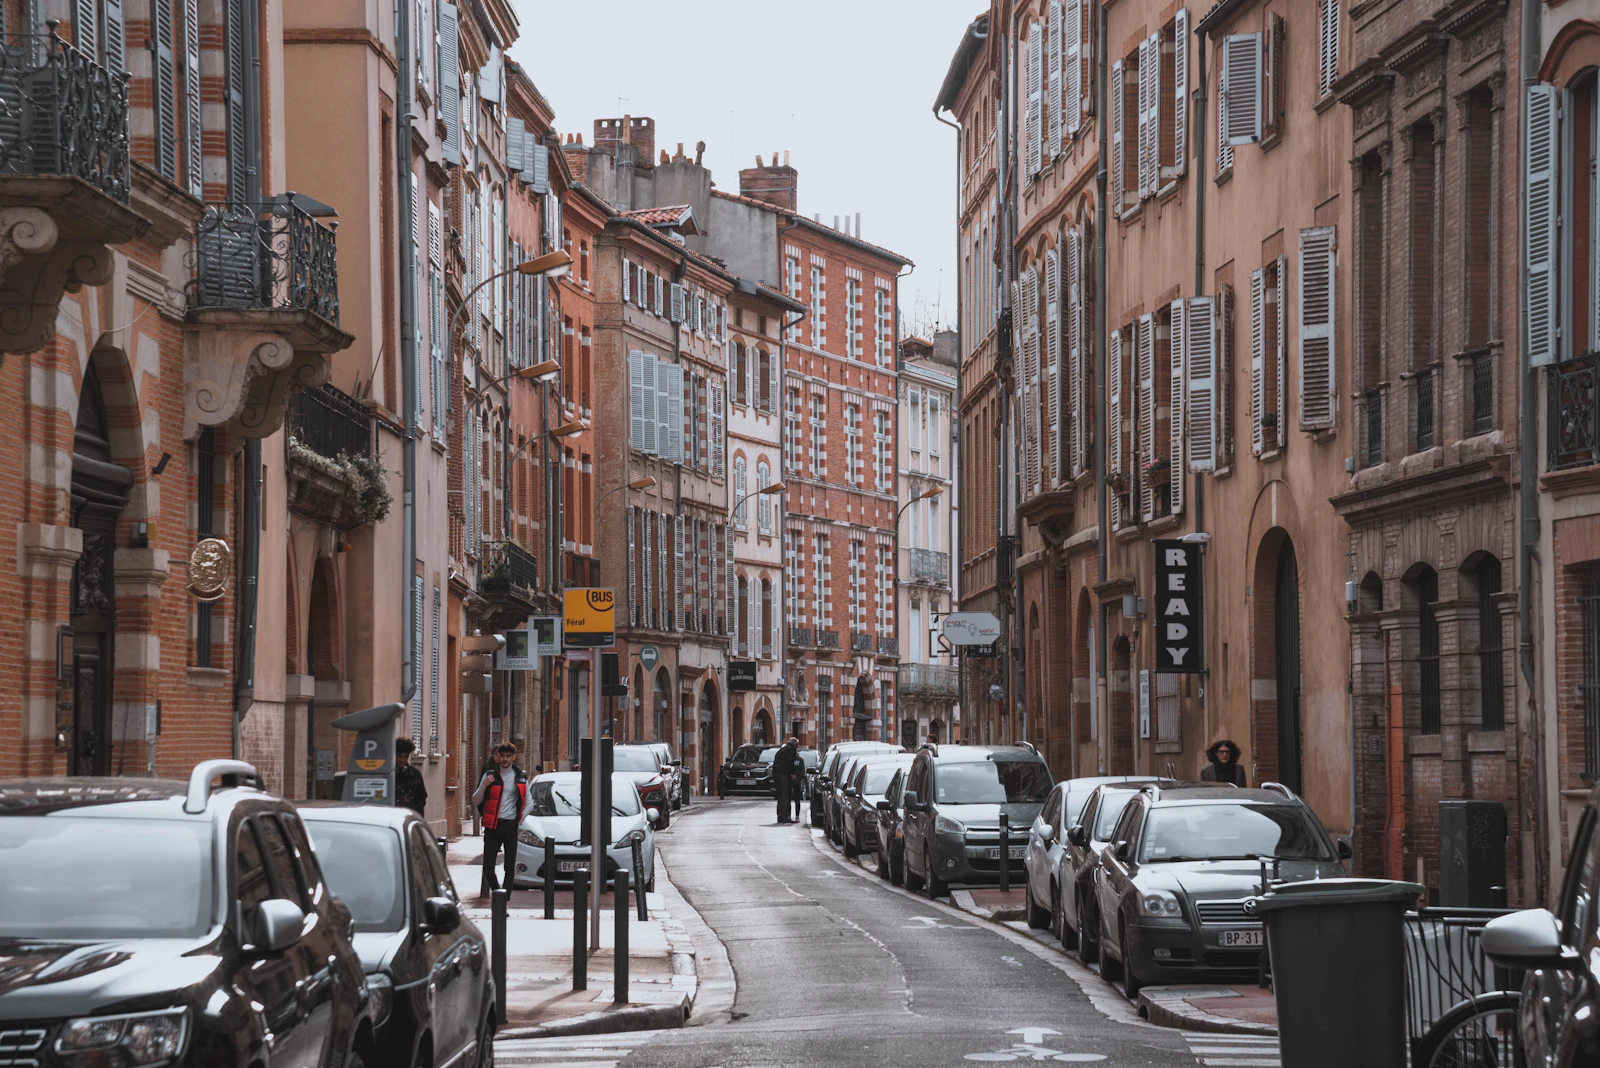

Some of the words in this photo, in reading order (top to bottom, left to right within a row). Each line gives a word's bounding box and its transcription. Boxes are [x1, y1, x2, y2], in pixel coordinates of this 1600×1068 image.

[591, 591, 613, 602] BUS
[1164, 548, 1191, 665] READY
[566, 618, 585, 626] Féral
[364, 740, 377, 758] P
